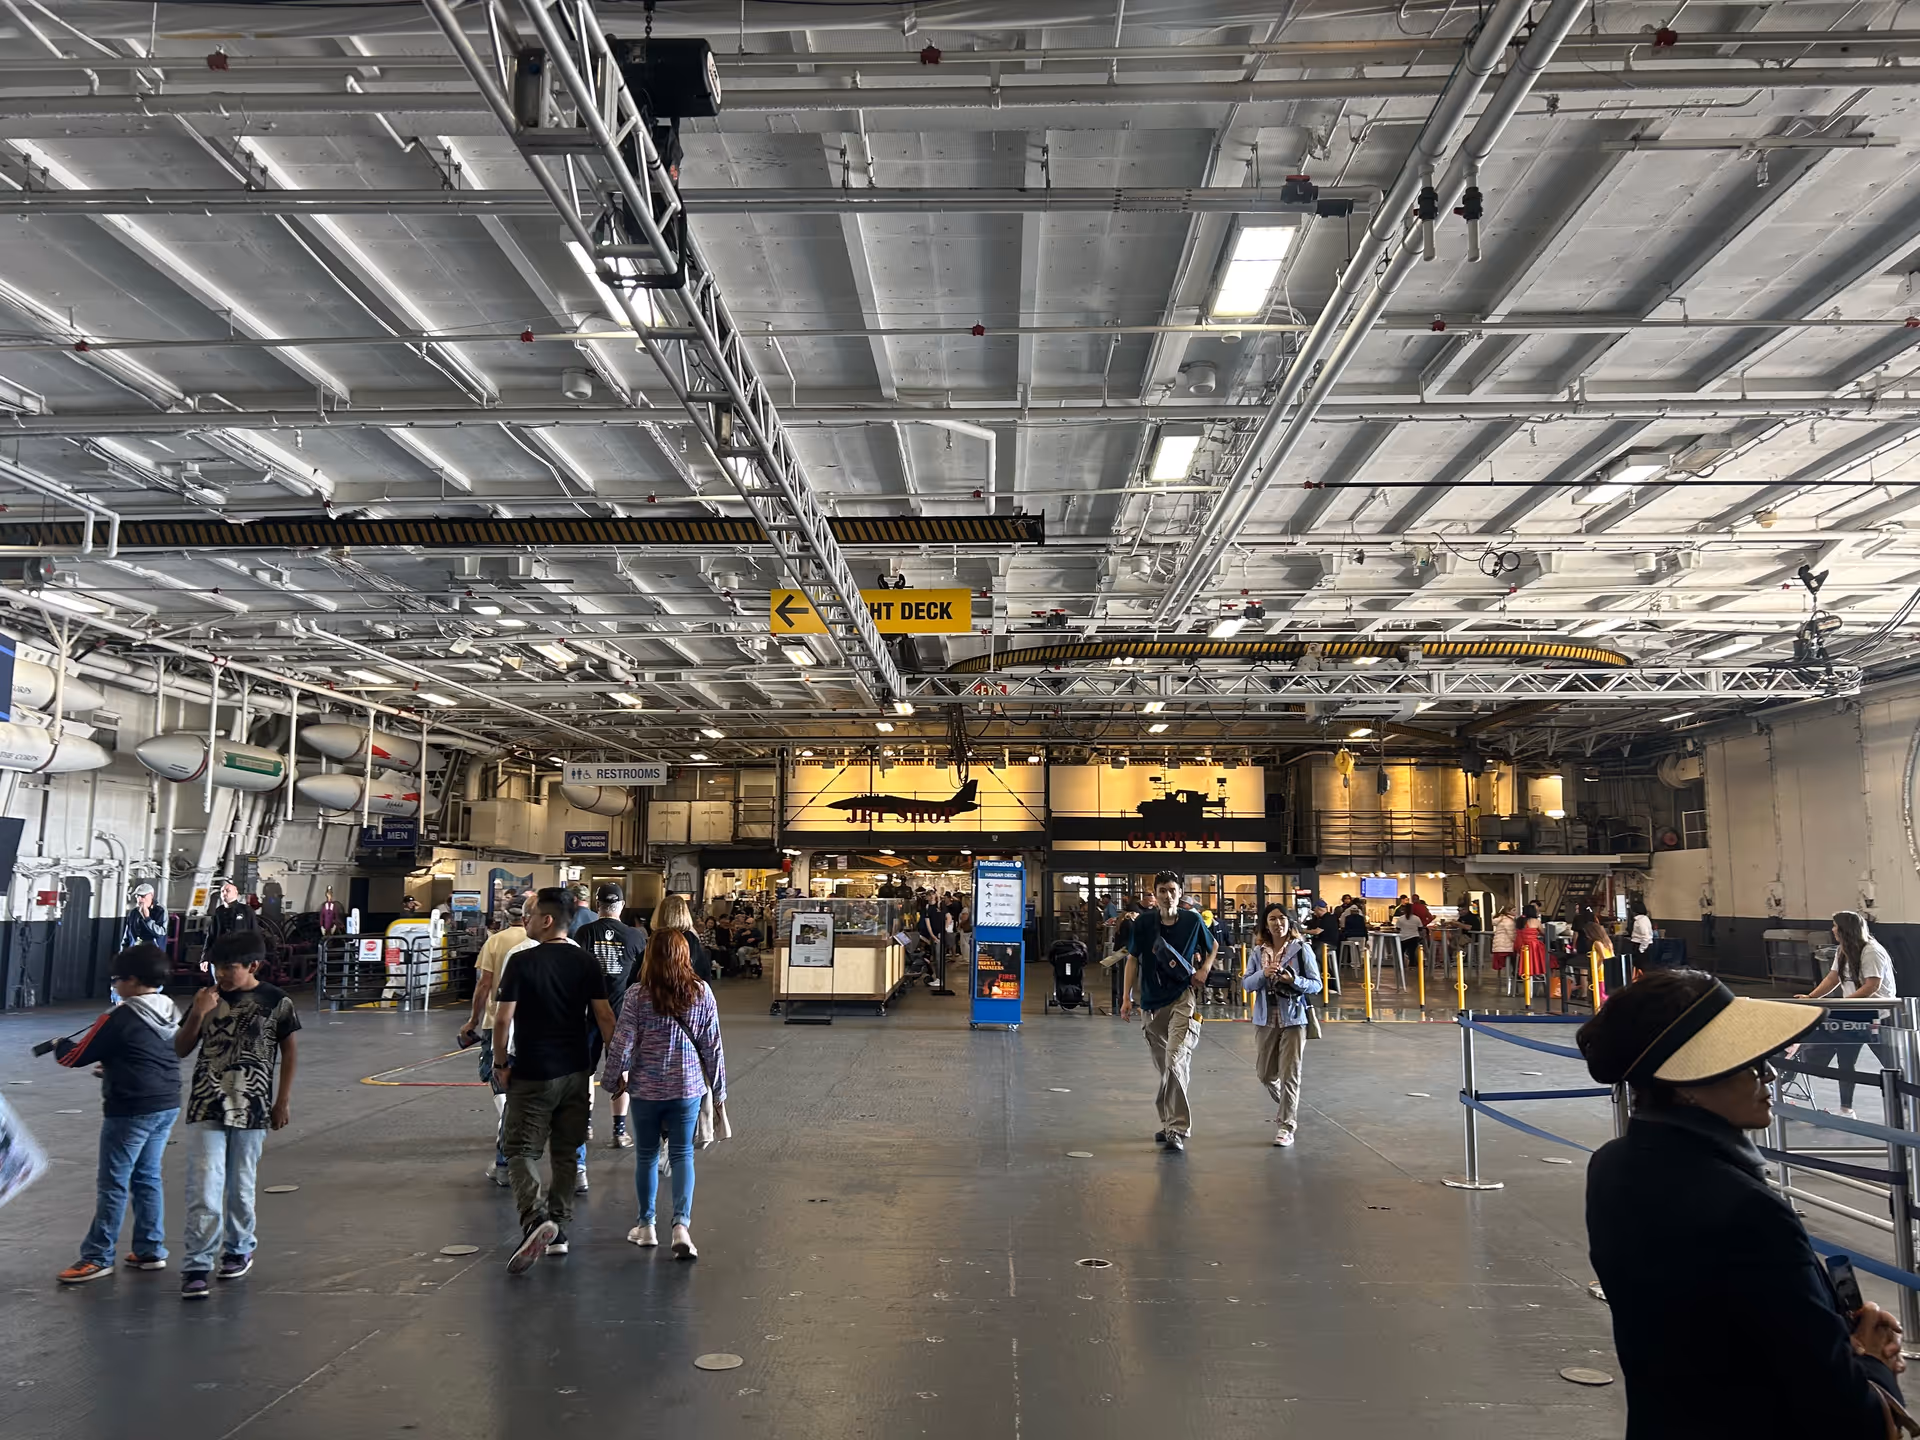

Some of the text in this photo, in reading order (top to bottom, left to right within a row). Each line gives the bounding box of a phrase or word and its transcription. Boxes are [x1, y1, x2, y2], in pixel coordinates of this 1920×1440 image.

[901, 602, 953, 620] DECK
[597, 768, 660, 779] RESTROOMS
[846, 807, 956, 824] JET SHOP
[387, 831, 408, 840] MEN
[1128, 831, 1221, 849] CAFE 41
[1822, 1022, 1840, 1031] TO
[1842, 1022, 1870, 1031] EXIT
